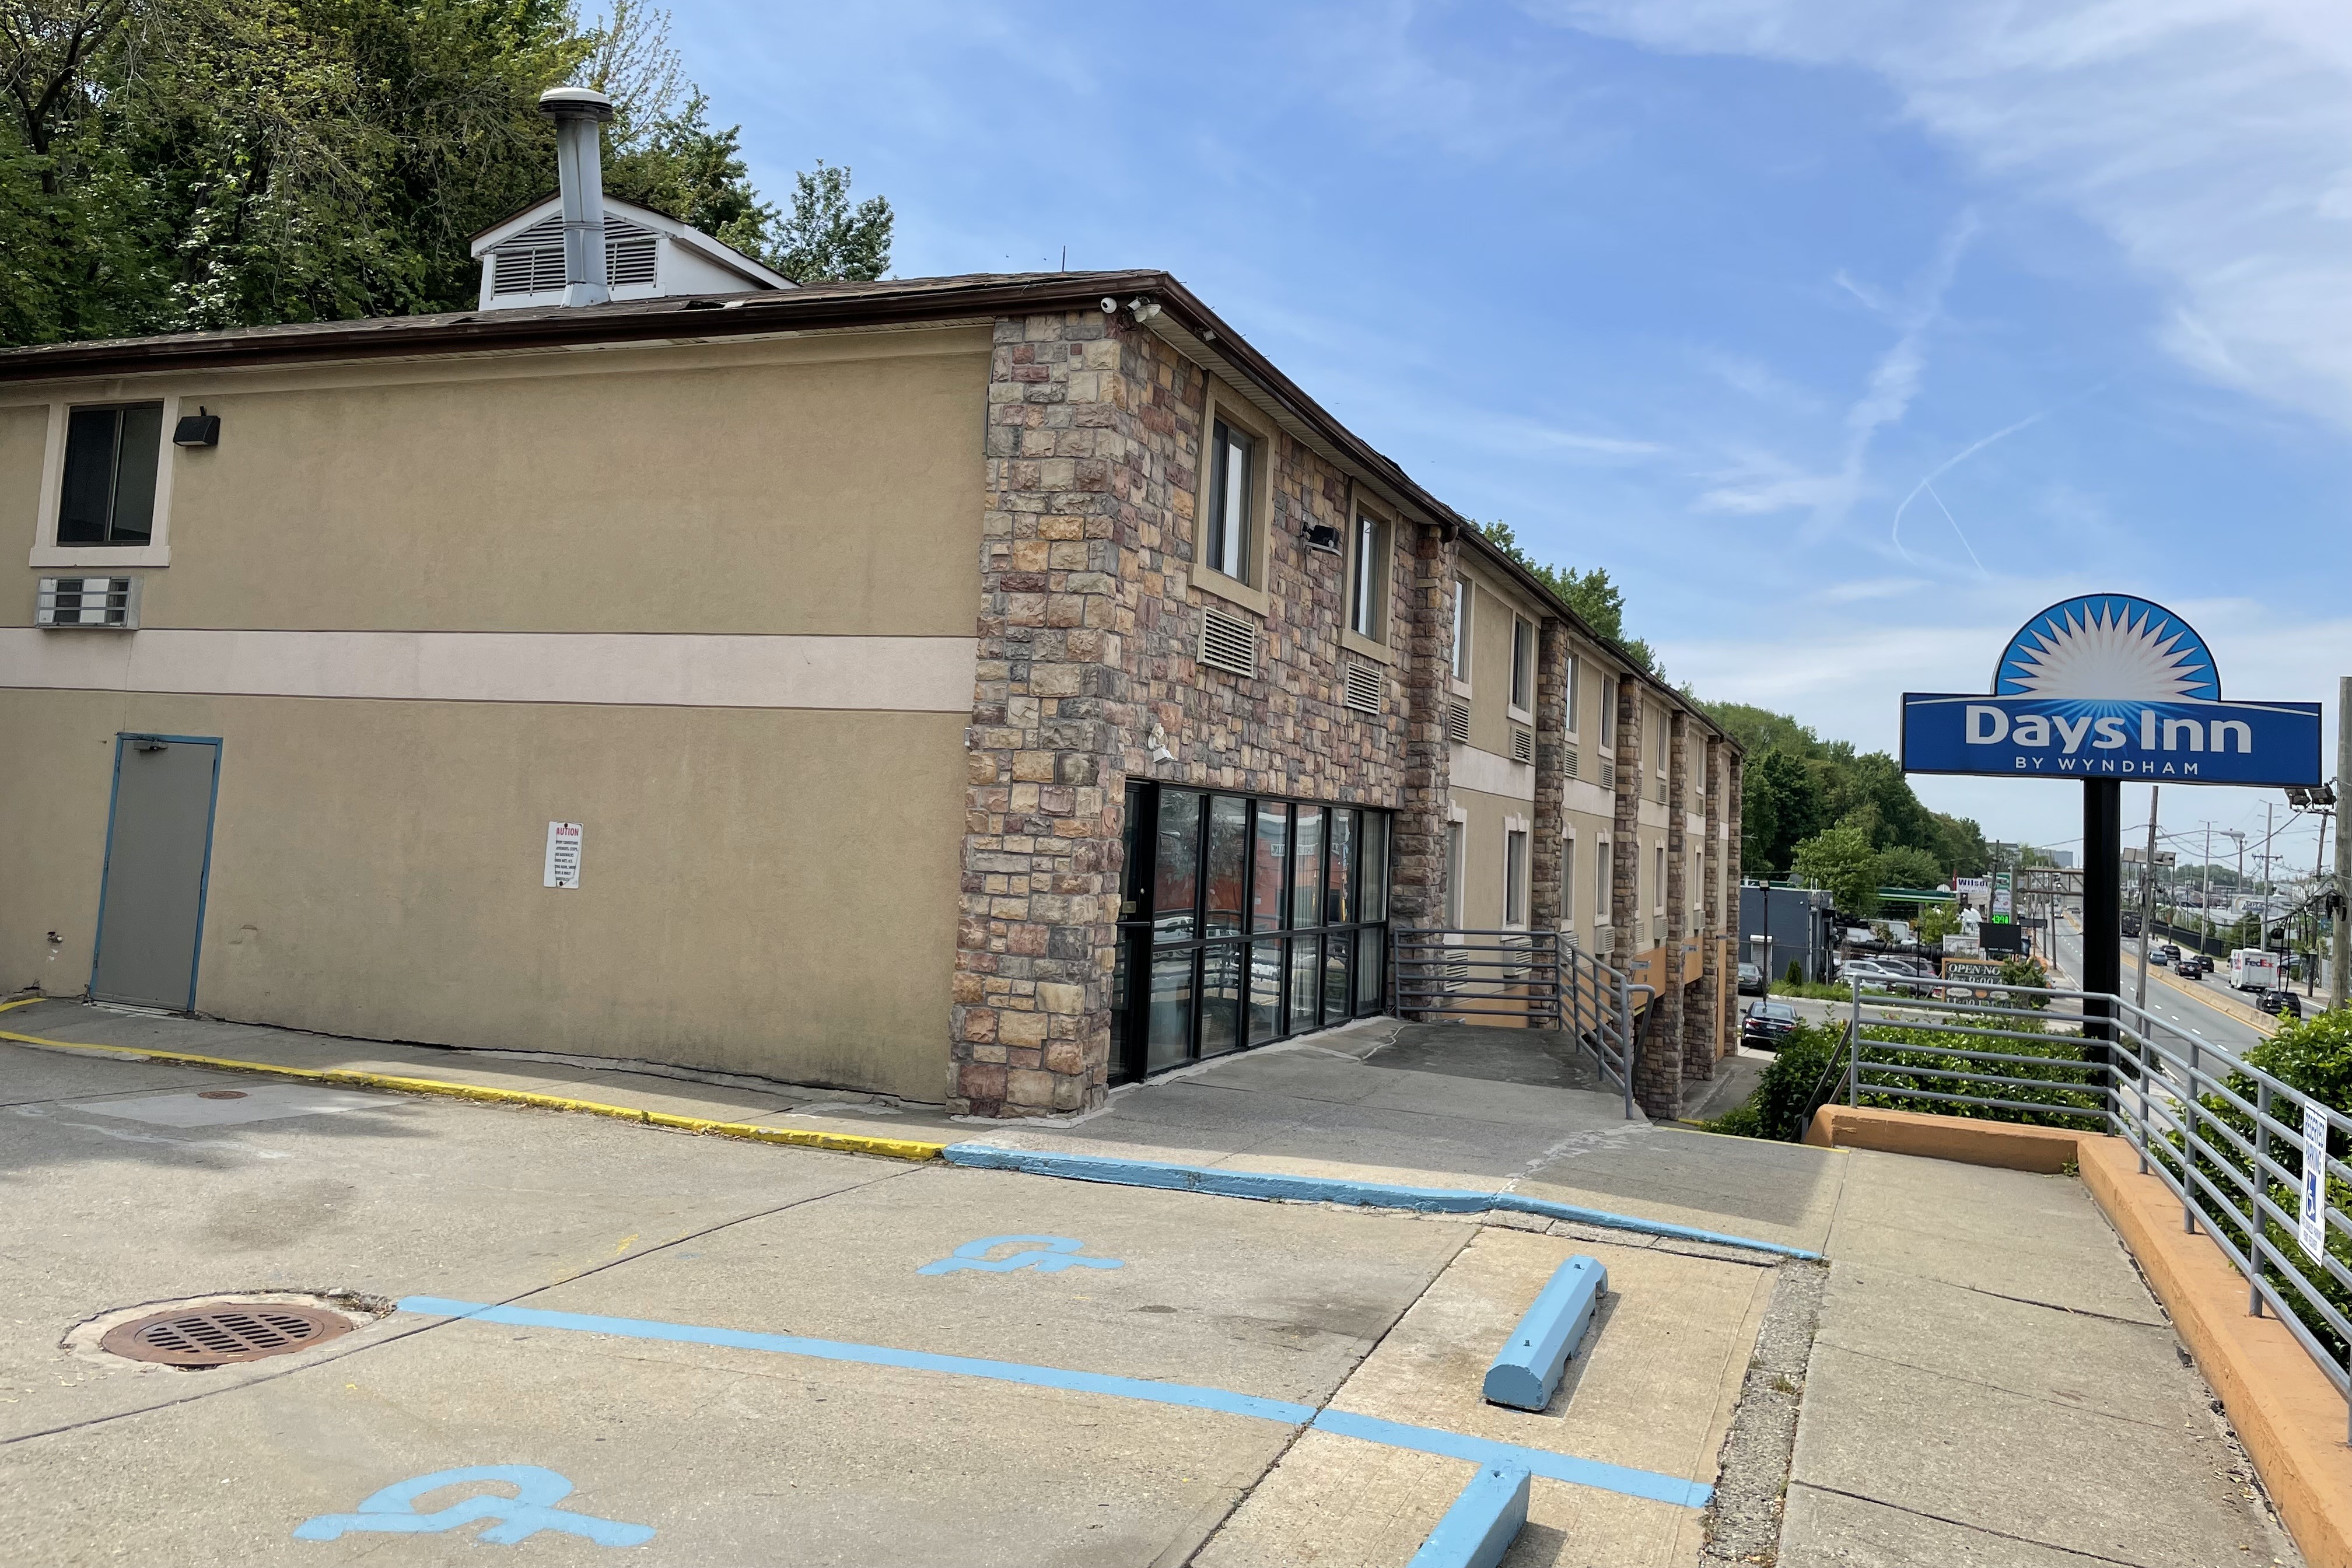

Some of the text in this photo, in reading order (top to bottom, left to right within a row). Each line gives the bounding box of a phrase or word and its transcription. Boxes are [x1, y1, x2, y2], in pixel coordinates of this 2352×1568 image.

[1965, 705, 2252, 754] Days Inn
[2015, 756, 2198, 776] BY WYNDHAM
[1948, 964, 1981, 974] OPEN
[2245, 957, 2274, 968] FedEx
